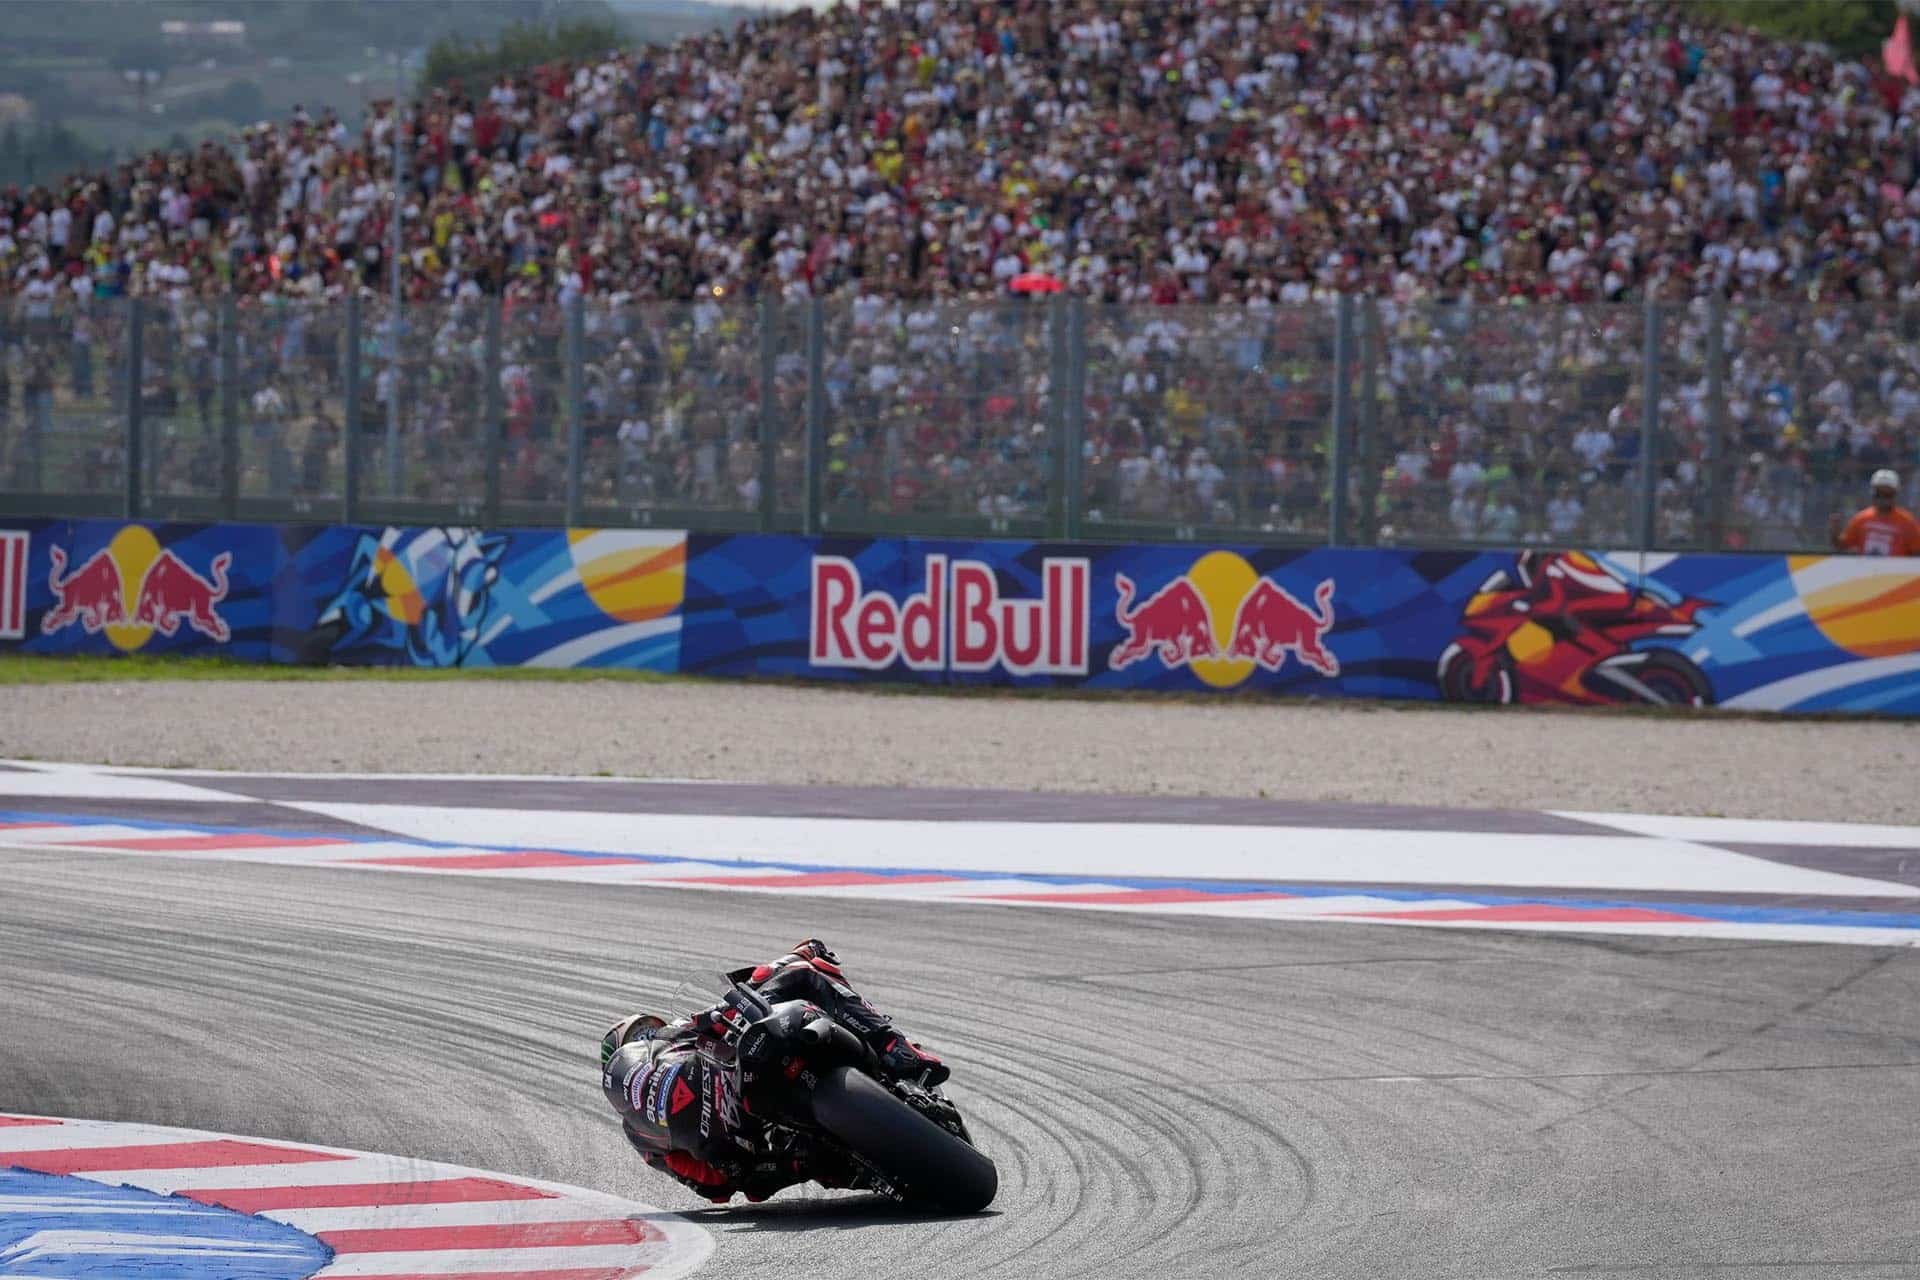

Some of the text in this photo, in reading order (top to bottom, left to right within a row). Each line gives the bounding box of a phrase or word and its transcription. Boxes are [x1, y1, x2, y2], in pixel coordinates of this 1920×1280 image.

[809, 554, 1091, 676] Red Bull
[646, 1062, 672, 1123] aprilia
[700, 1056, 717, 1138] DAINESE
